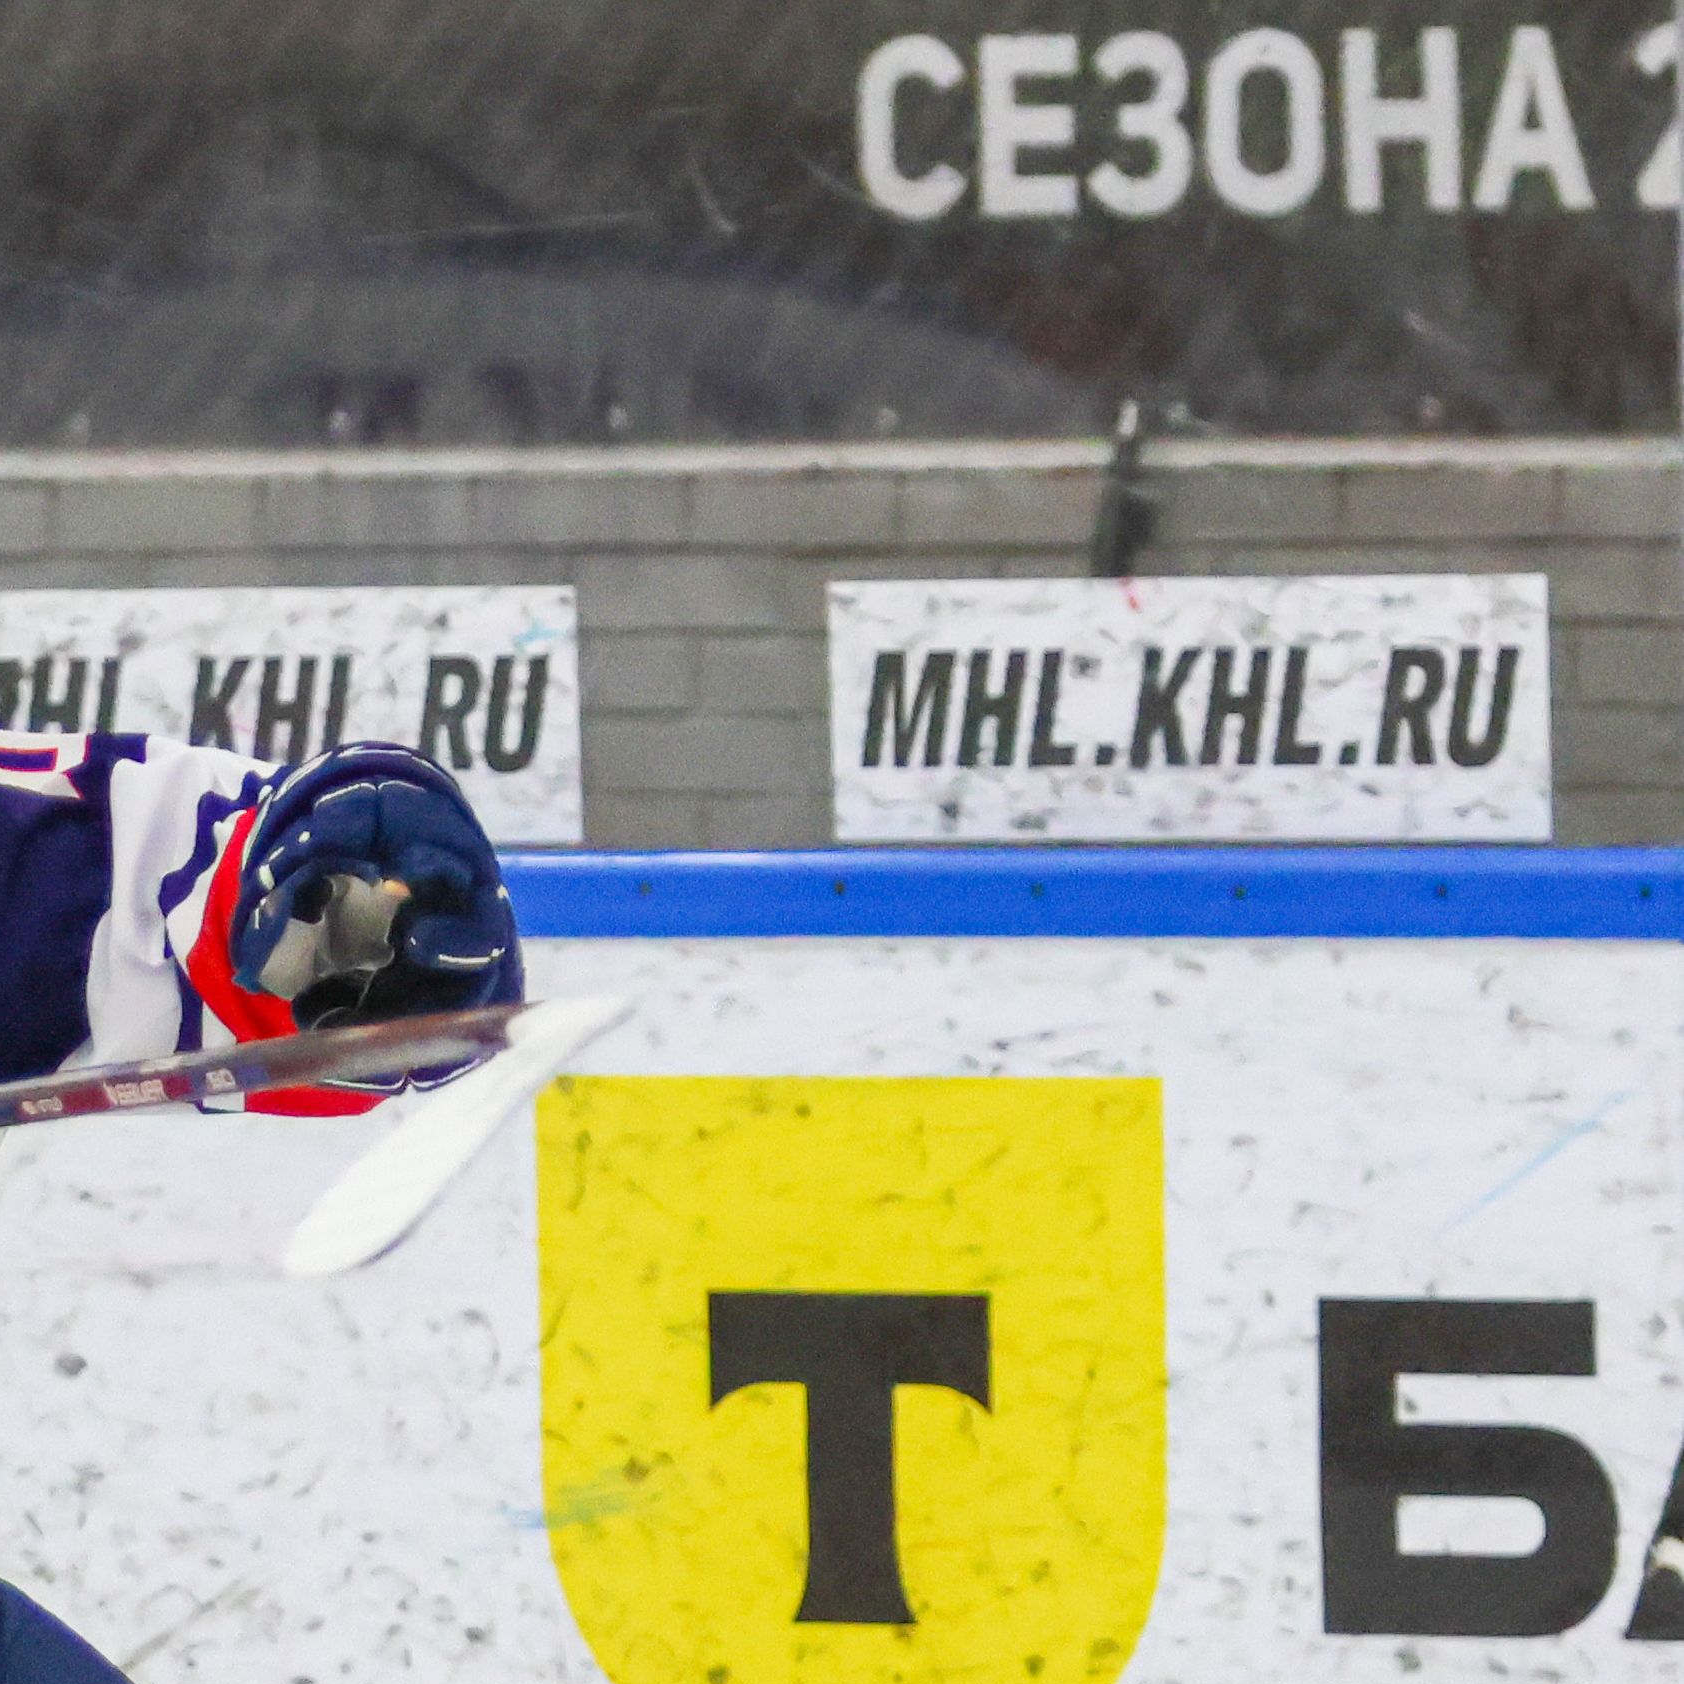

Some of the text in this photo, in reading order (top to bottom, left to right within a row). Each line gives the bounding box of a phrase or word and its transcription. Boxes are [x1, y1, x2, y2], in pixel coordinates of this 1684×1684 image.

[855, 26, 1597, 220] СЕЗОНА
[859, 643, 1524, 771] MHL.KHL.RU
[1317, 1296, 1684, 1641] Б
